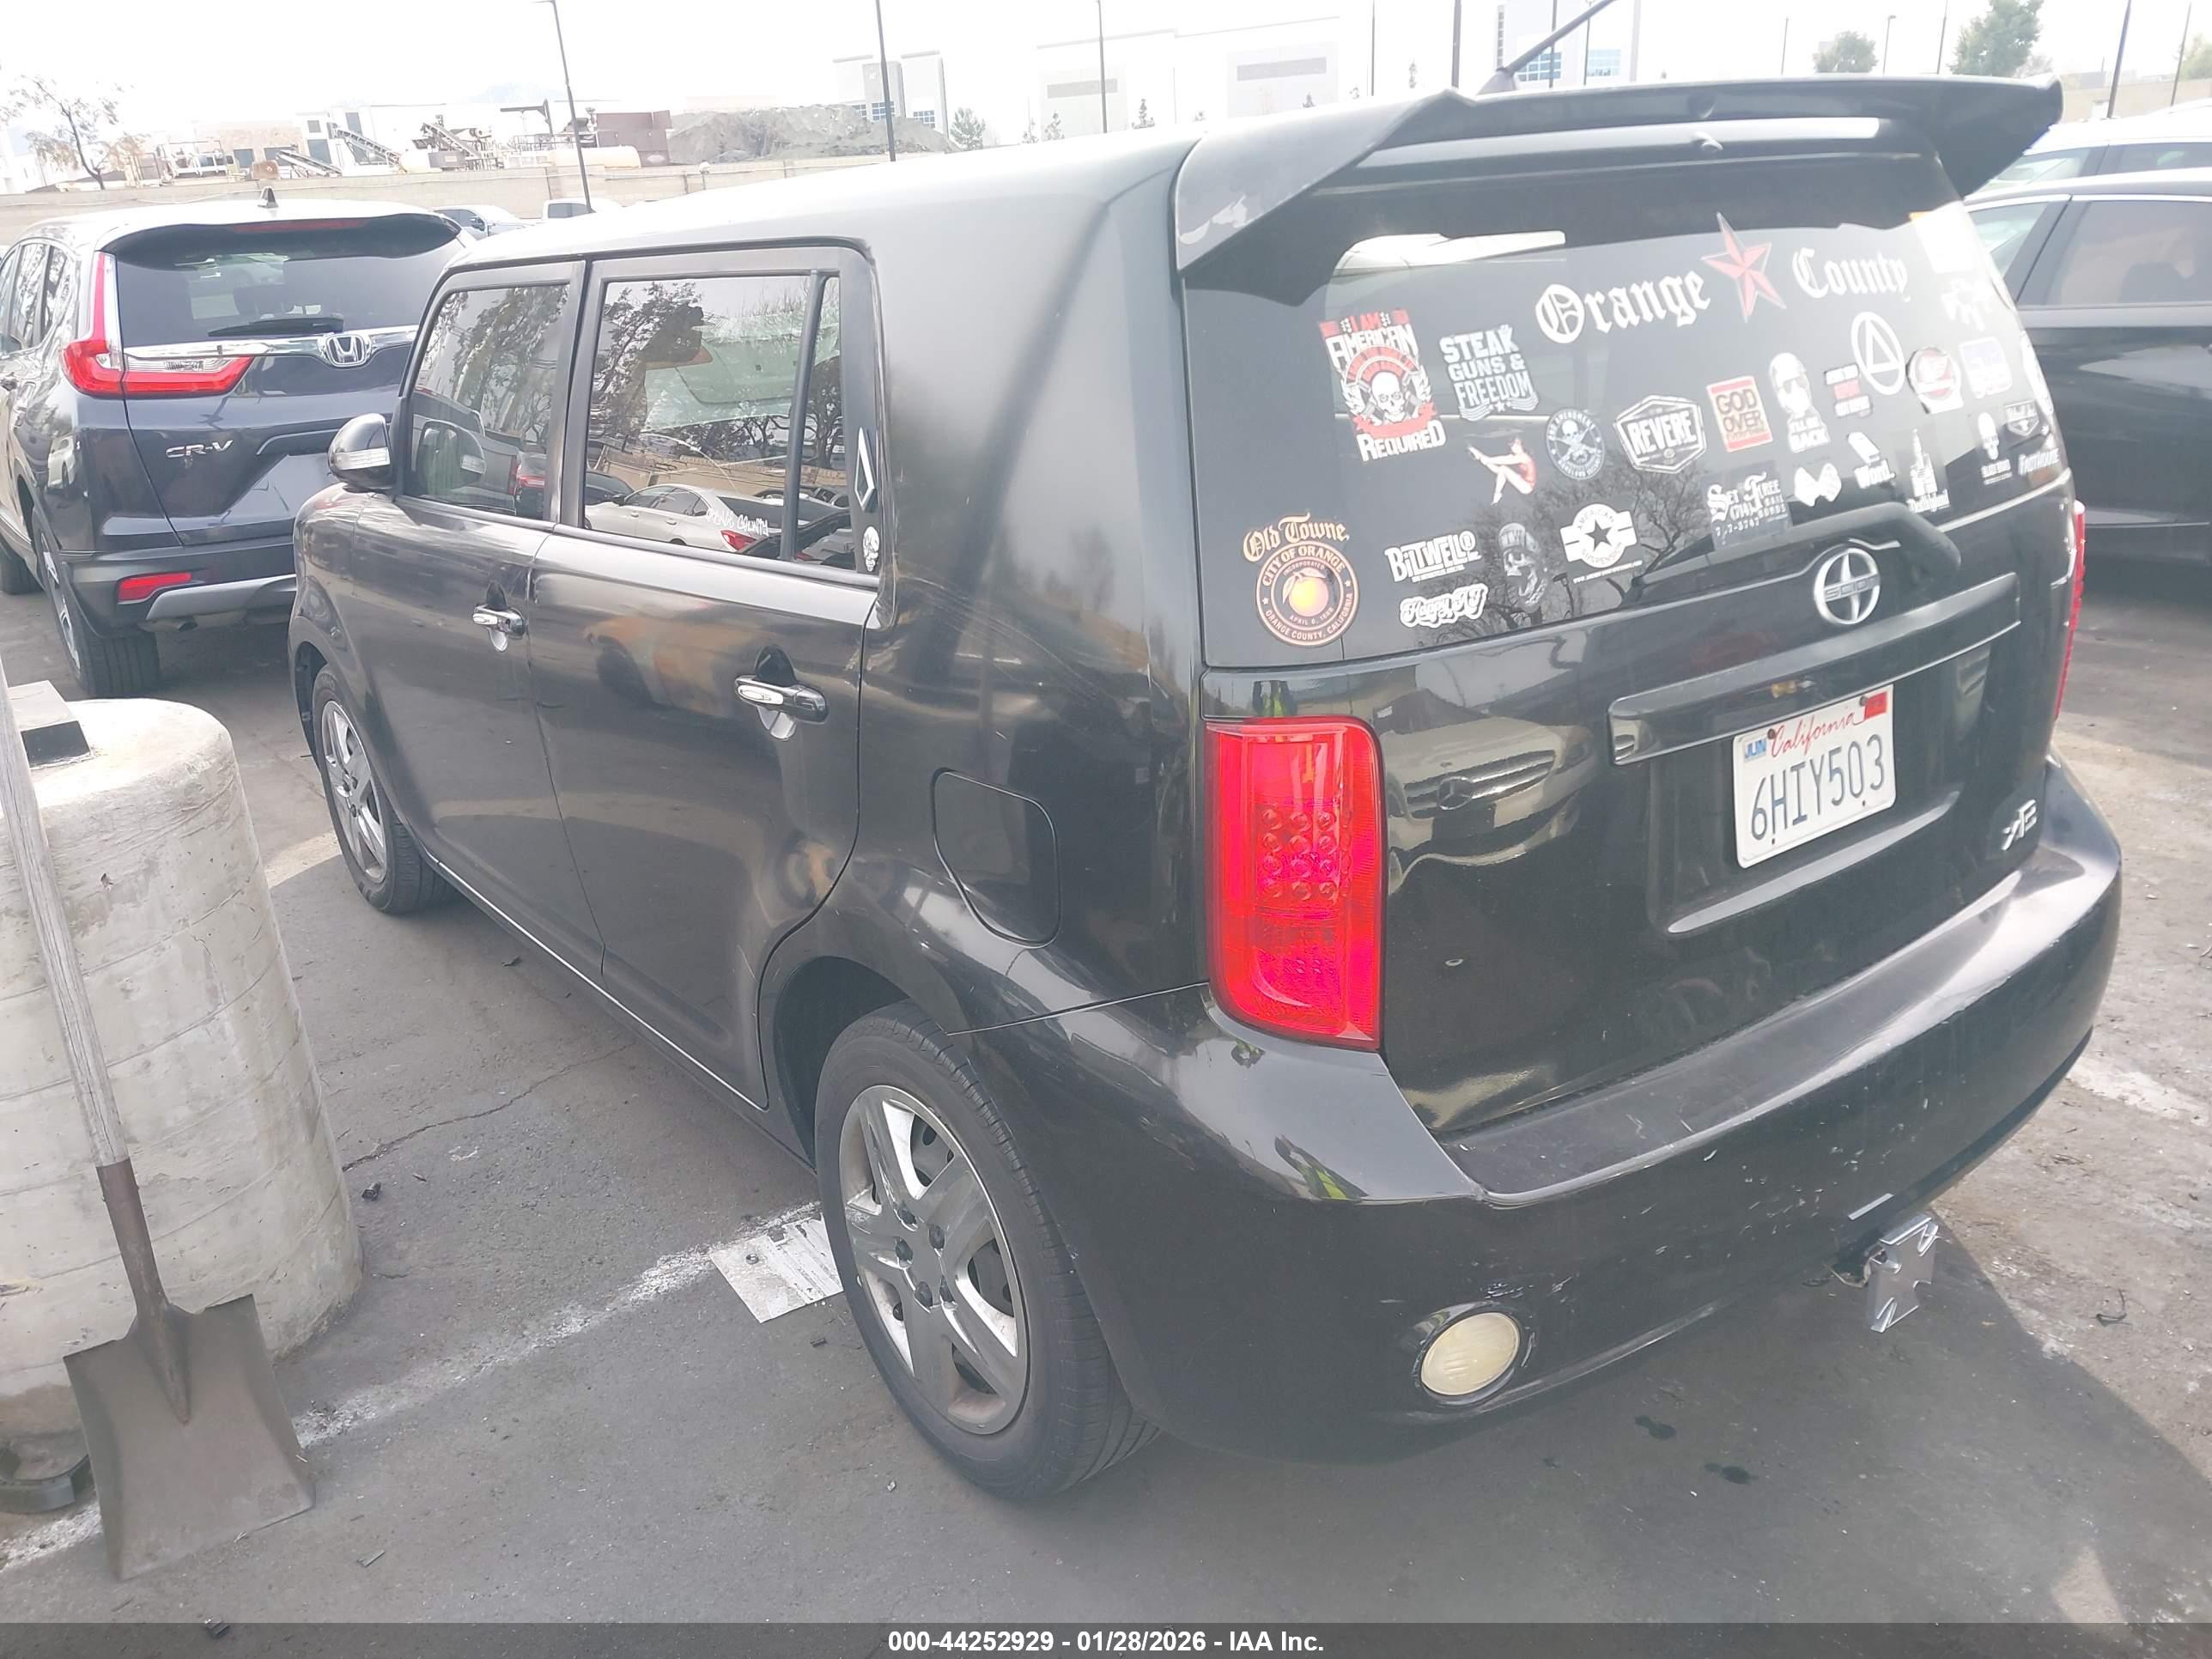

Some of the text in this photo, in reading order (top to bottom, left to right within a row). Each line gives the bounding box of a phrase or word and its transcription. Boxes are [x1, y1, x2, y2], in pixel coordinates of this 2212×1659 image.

[1535, 247, 1911, 343] Orange County
[1439, 325, 1520, 363] STEAK
[1448, 353, 1526, 381] GUNS &
[1454, 370, 1534, 410] FREEDOM
[1717, 389, 1757, 415] GOD
[1357, 419, 1446, 461] REQUIRED
[1627, 410, 1697, 456] REVERE
[1723, 410, 1763, 432] OVER
[166, 440, 234, 459] CR-V
[1243, 512, 1350, 562] Old Towne
[1262, 545, 1345, 586] CITY OF ORANGE
[1265, 609, 1290, 635] ORANGE
[1327, 592, 1353, 635] CALIFORNIA
[1771, 709, 1866, 757] California
[1751, 733, 1885, 841] 6HIY503
